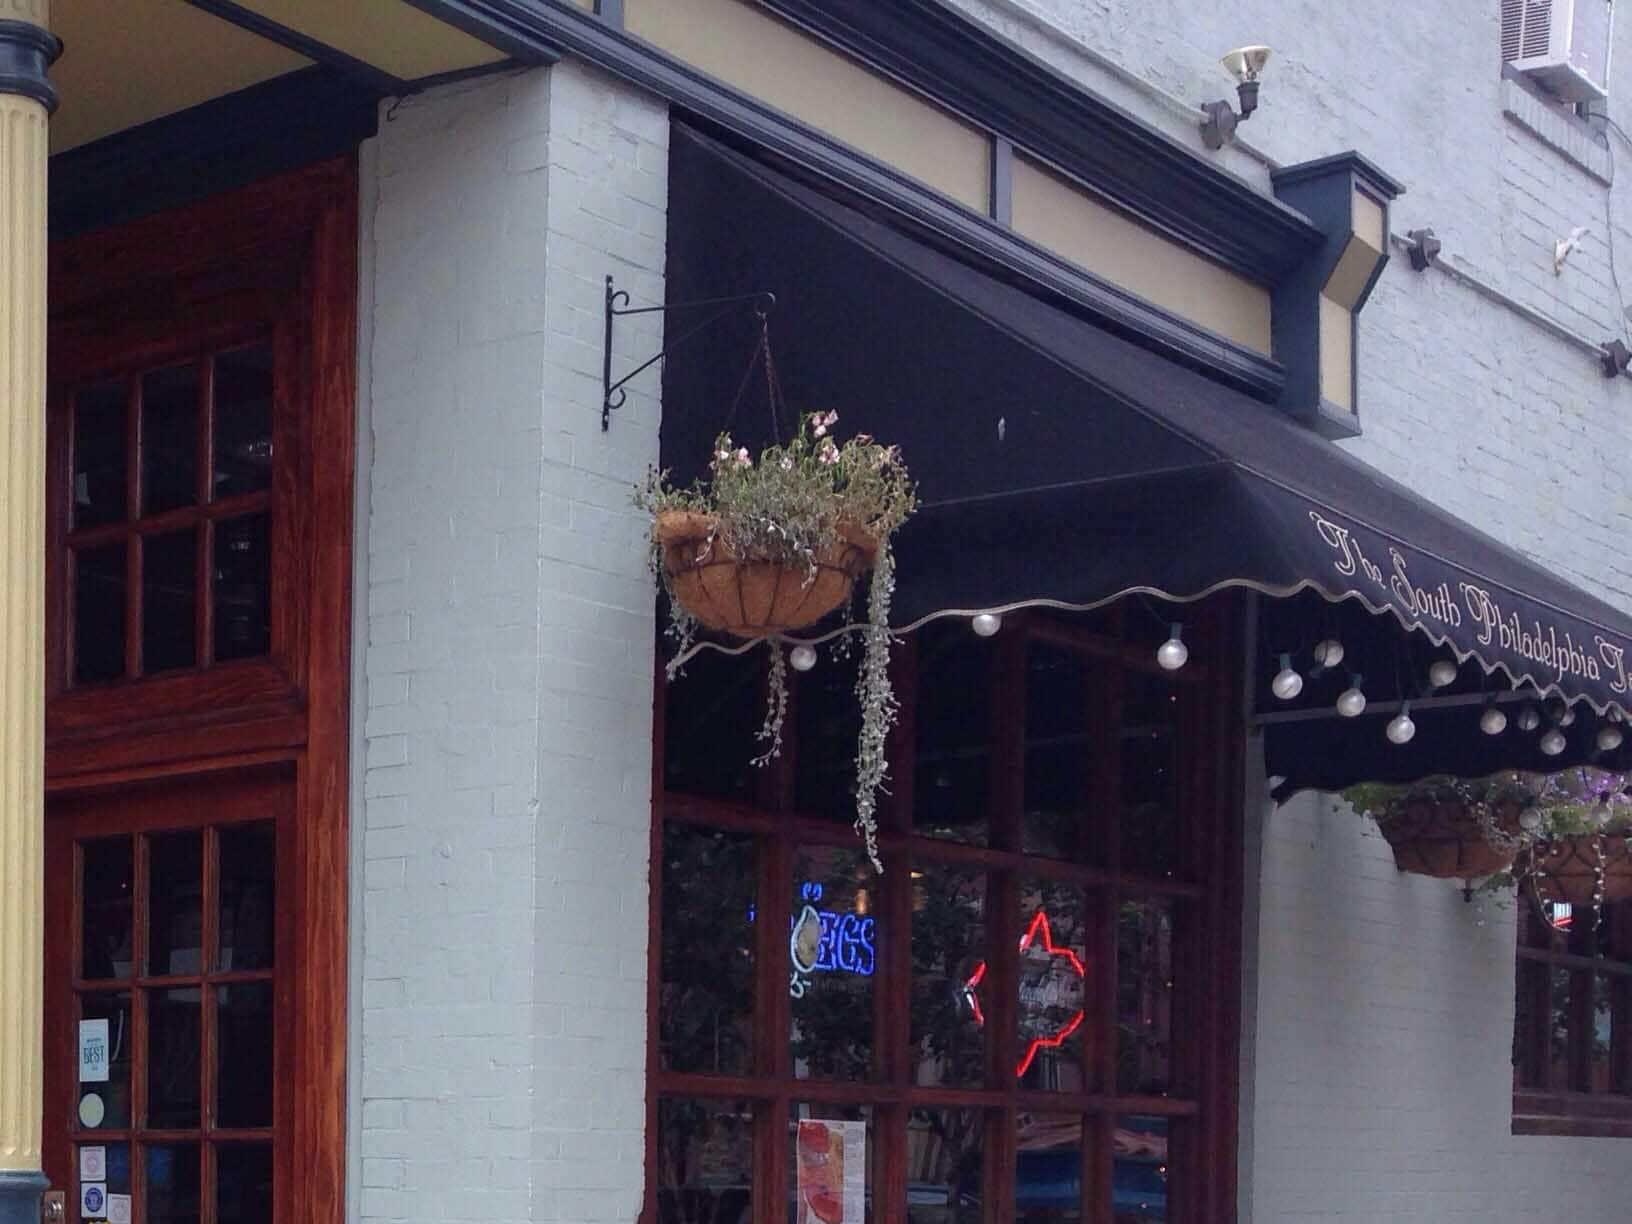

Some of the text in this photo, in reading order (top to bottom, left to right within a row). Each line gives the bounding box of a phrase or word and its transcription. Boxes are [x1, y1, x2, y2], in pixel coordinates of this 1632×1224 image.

[1309, 511, 1386, 590] The
[1389, 547, 1461, 633] South
[1458, 581, 1601, 683] Philadelphia
[83, 1045, 105, 1065] BEST
